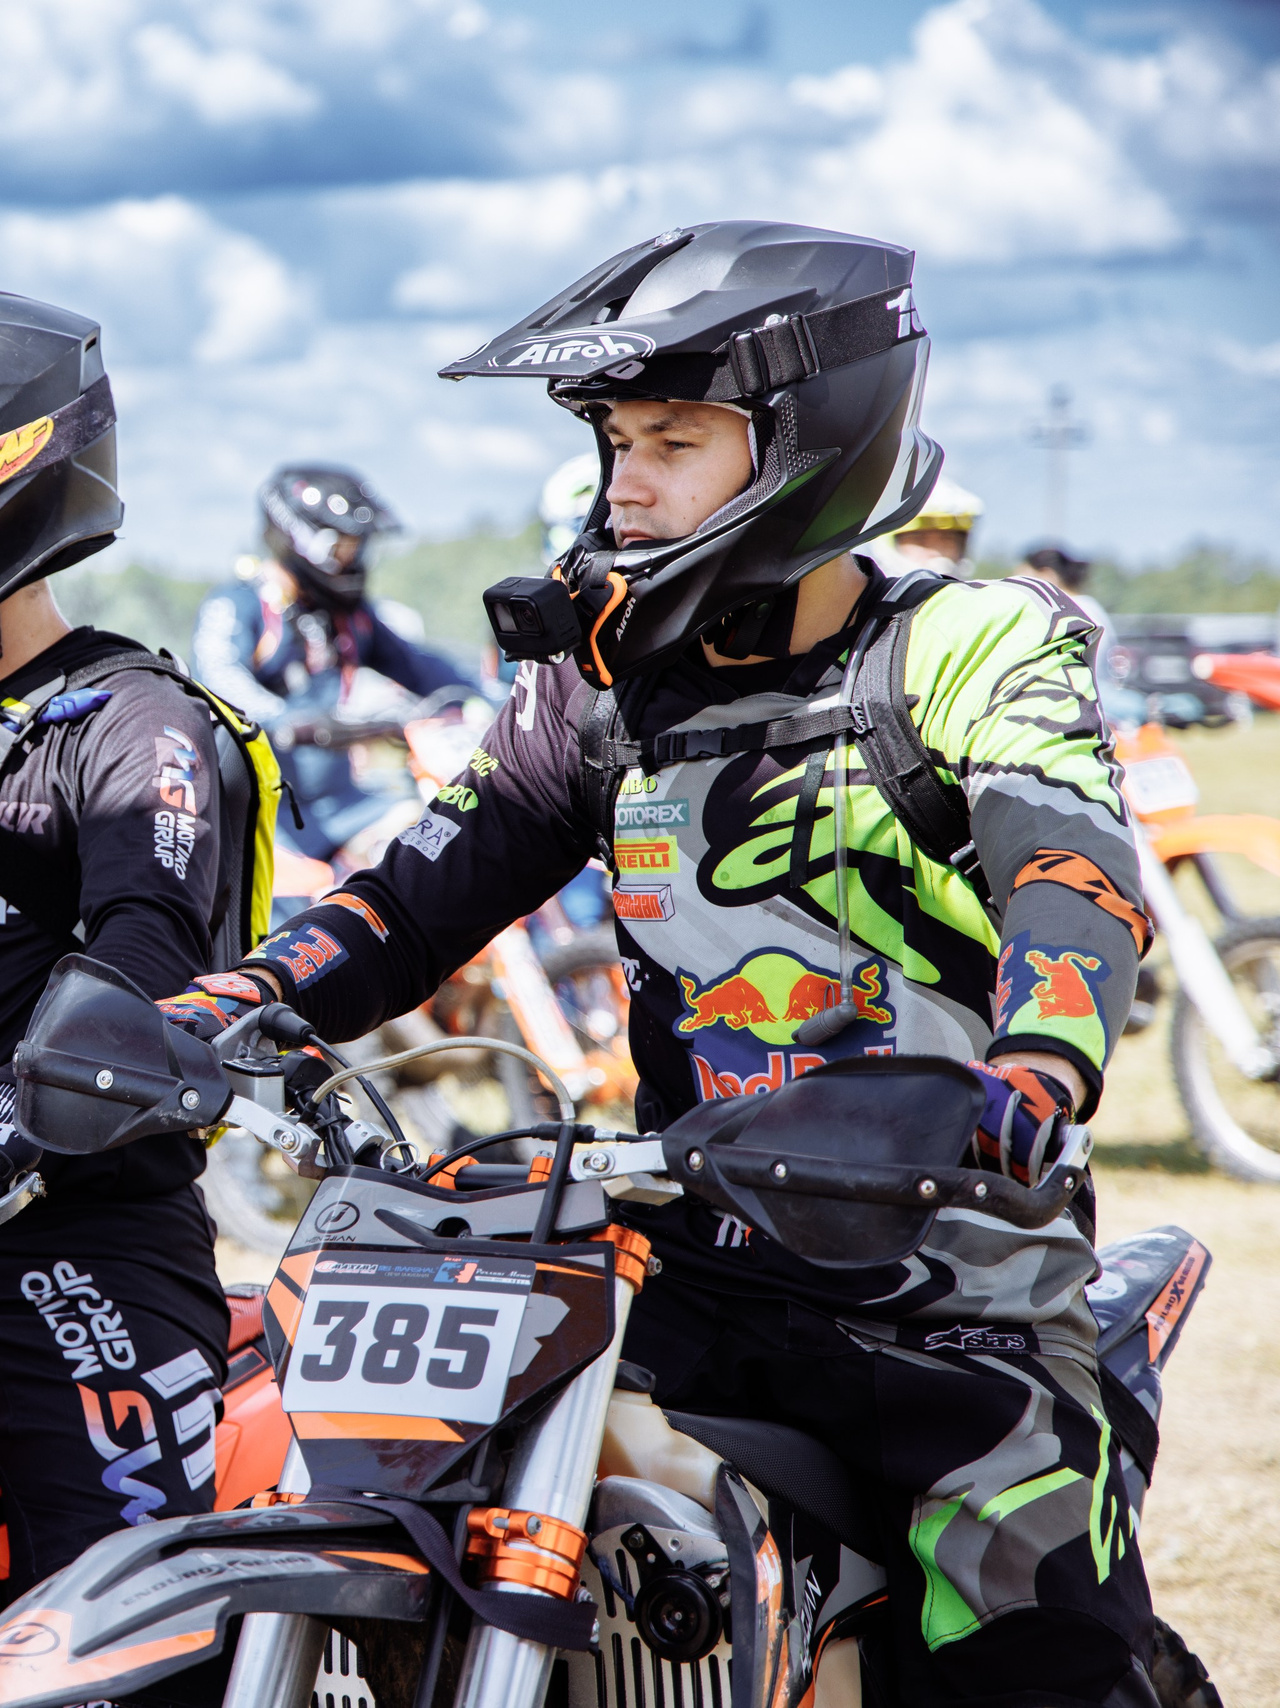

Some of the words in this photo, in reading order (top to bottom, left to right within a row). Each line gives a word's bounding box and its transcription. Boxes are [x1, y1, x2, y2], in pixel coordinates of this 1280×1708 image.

[507, 336, 638, 367] Airoh
[616, 597, 636, 641] Airoh
[615, 804, 684, 826] OTOREX
[175, 813, 196, 880] MOTIKO
[300, 1300, 500, 1391] 385
